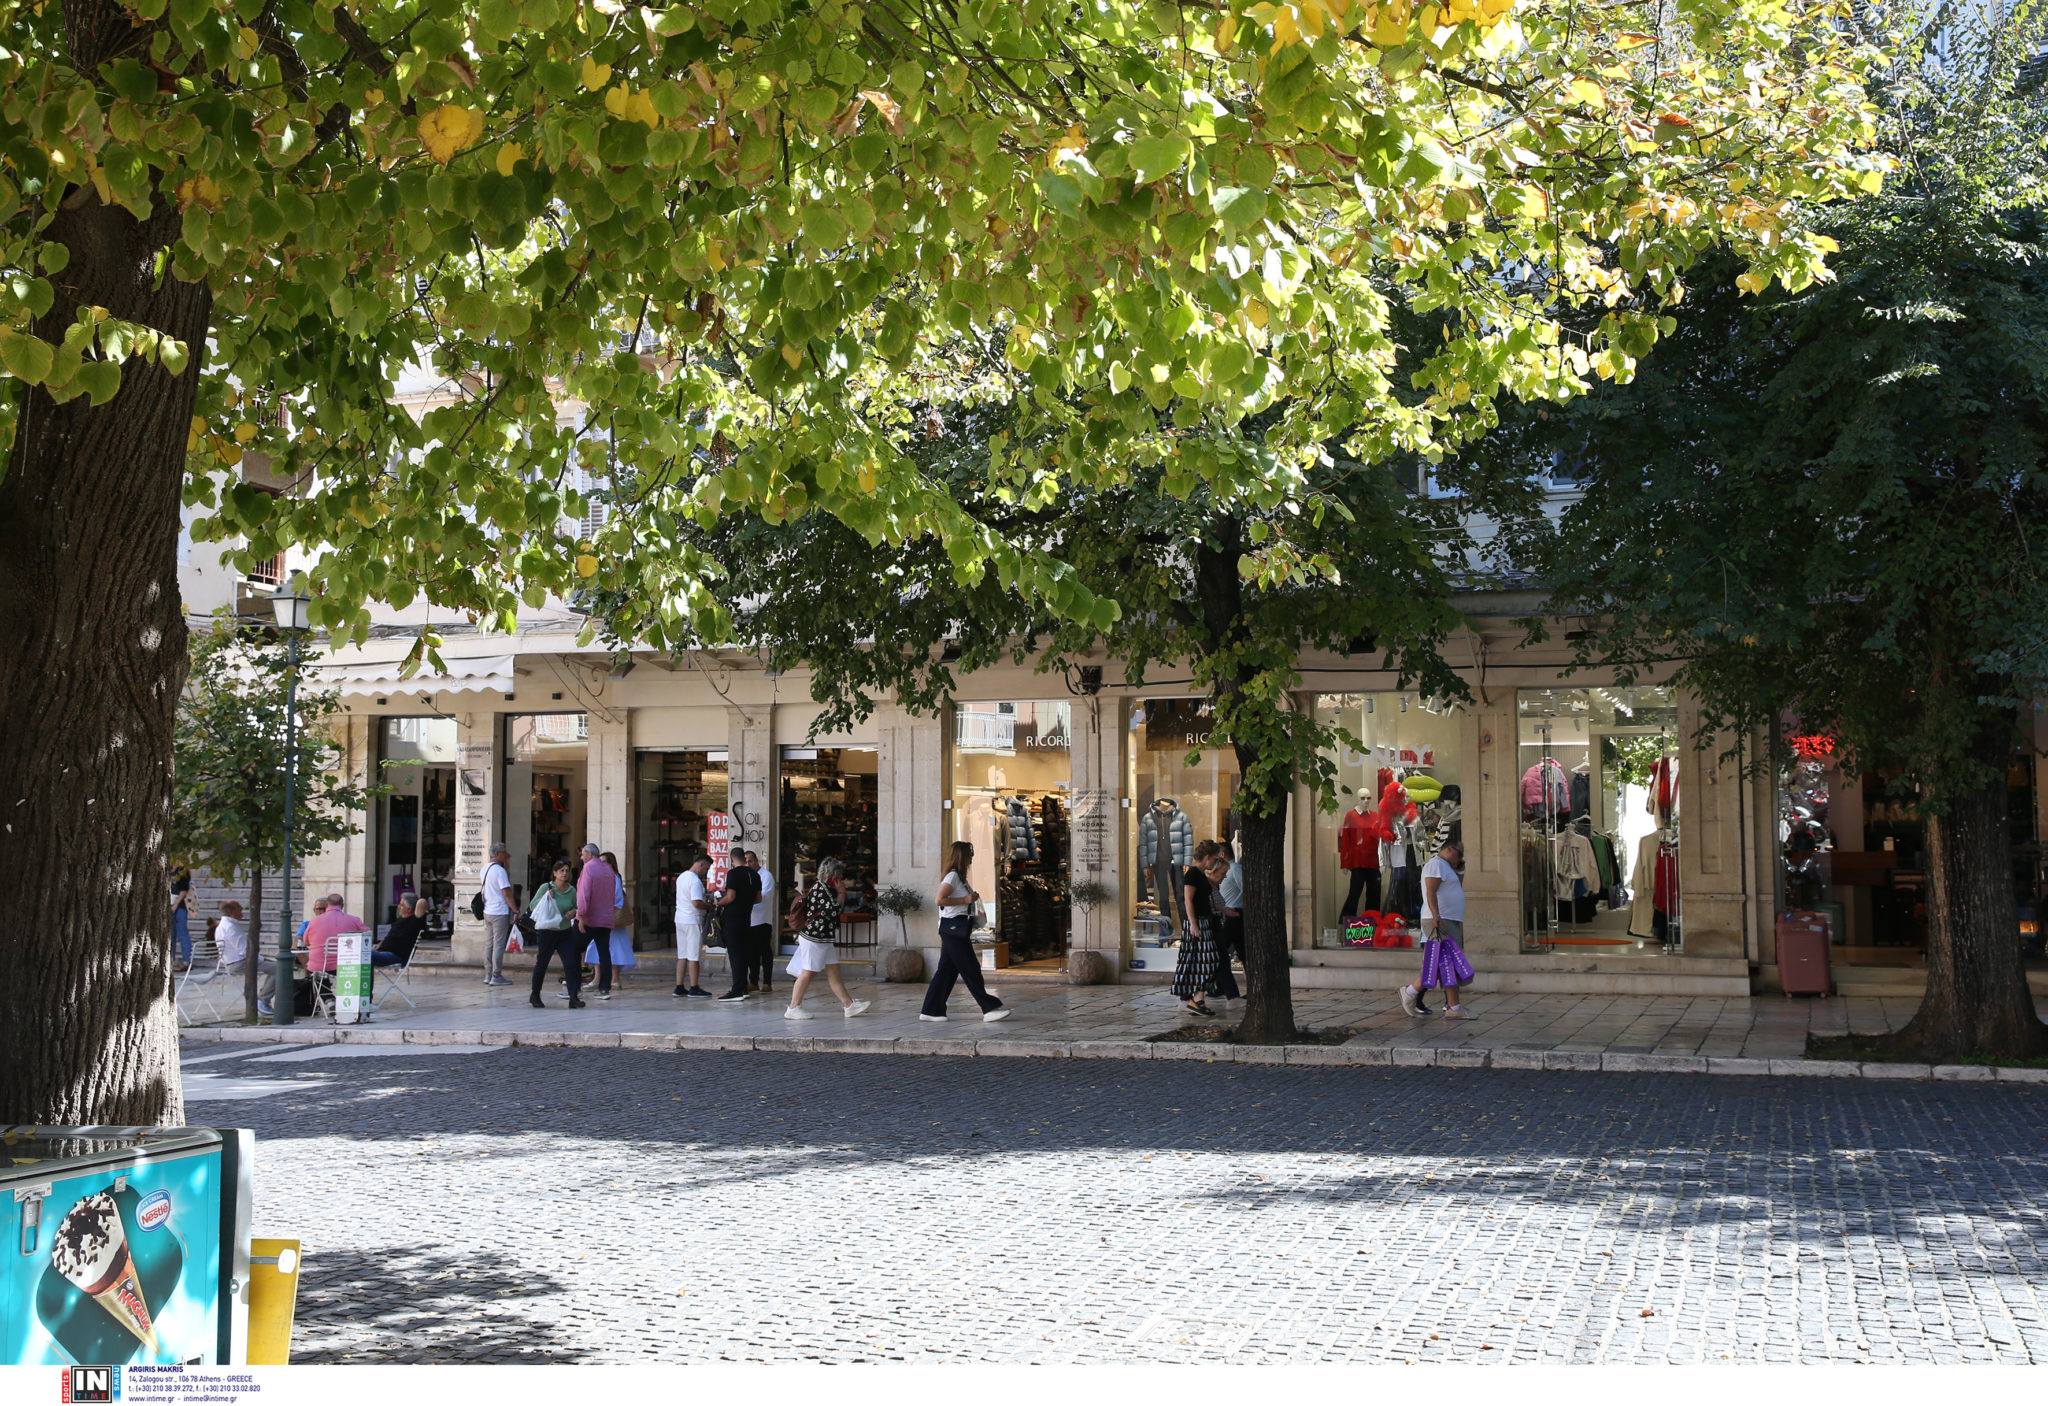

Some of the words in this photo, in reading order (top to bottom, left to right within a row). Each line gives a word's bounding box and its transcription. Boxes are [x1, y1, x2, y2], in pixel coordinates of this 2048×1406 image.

[1342, 744, 1432, 767] ONLY
[709, 815, 720, 827] 10
[709, 828, 729, 841] SUM
[709, 842, 729, 854] BAZ
